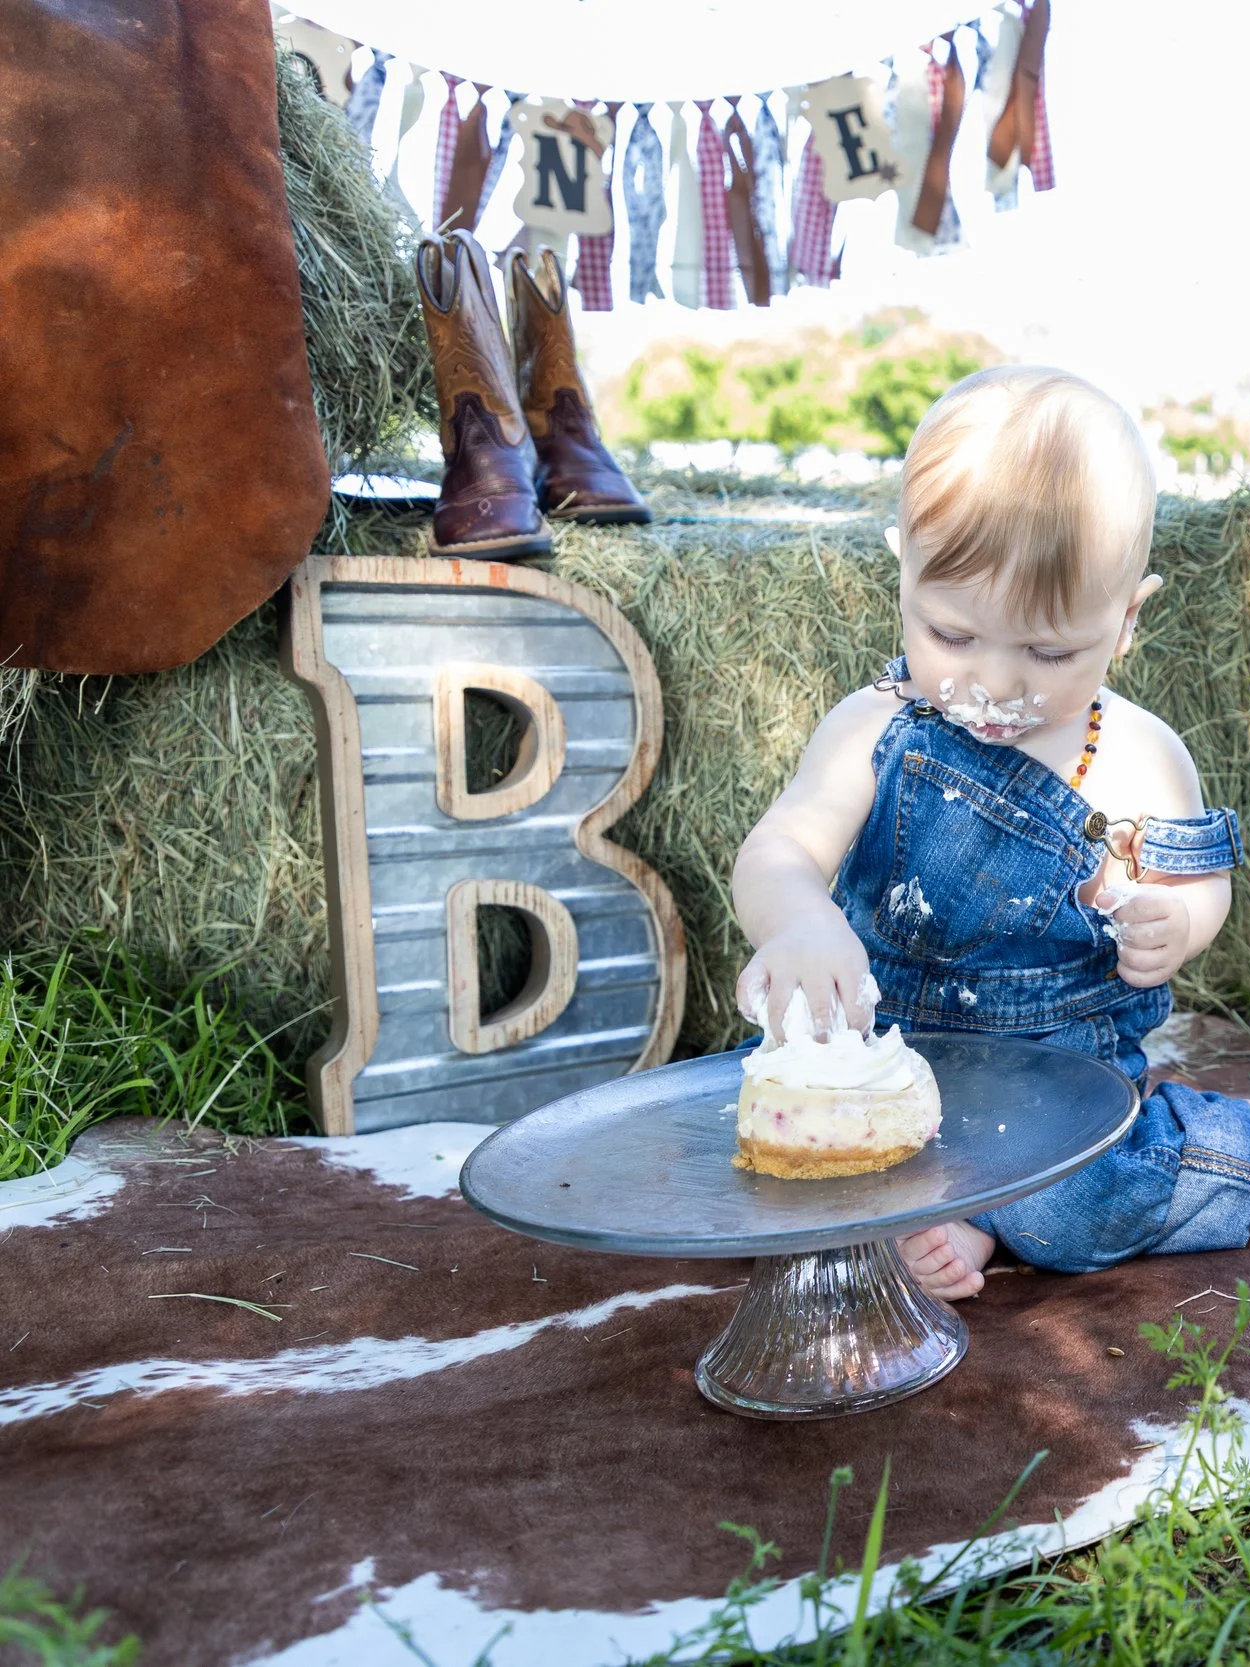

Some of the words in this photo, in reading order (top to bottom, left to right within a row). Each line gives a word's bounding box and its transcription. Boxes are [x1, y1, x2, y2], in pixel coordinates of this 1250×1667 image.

[532, 131, 589, 213] N
[827, 105, 881, 181] E
[286, 555, 687, 1136] B
